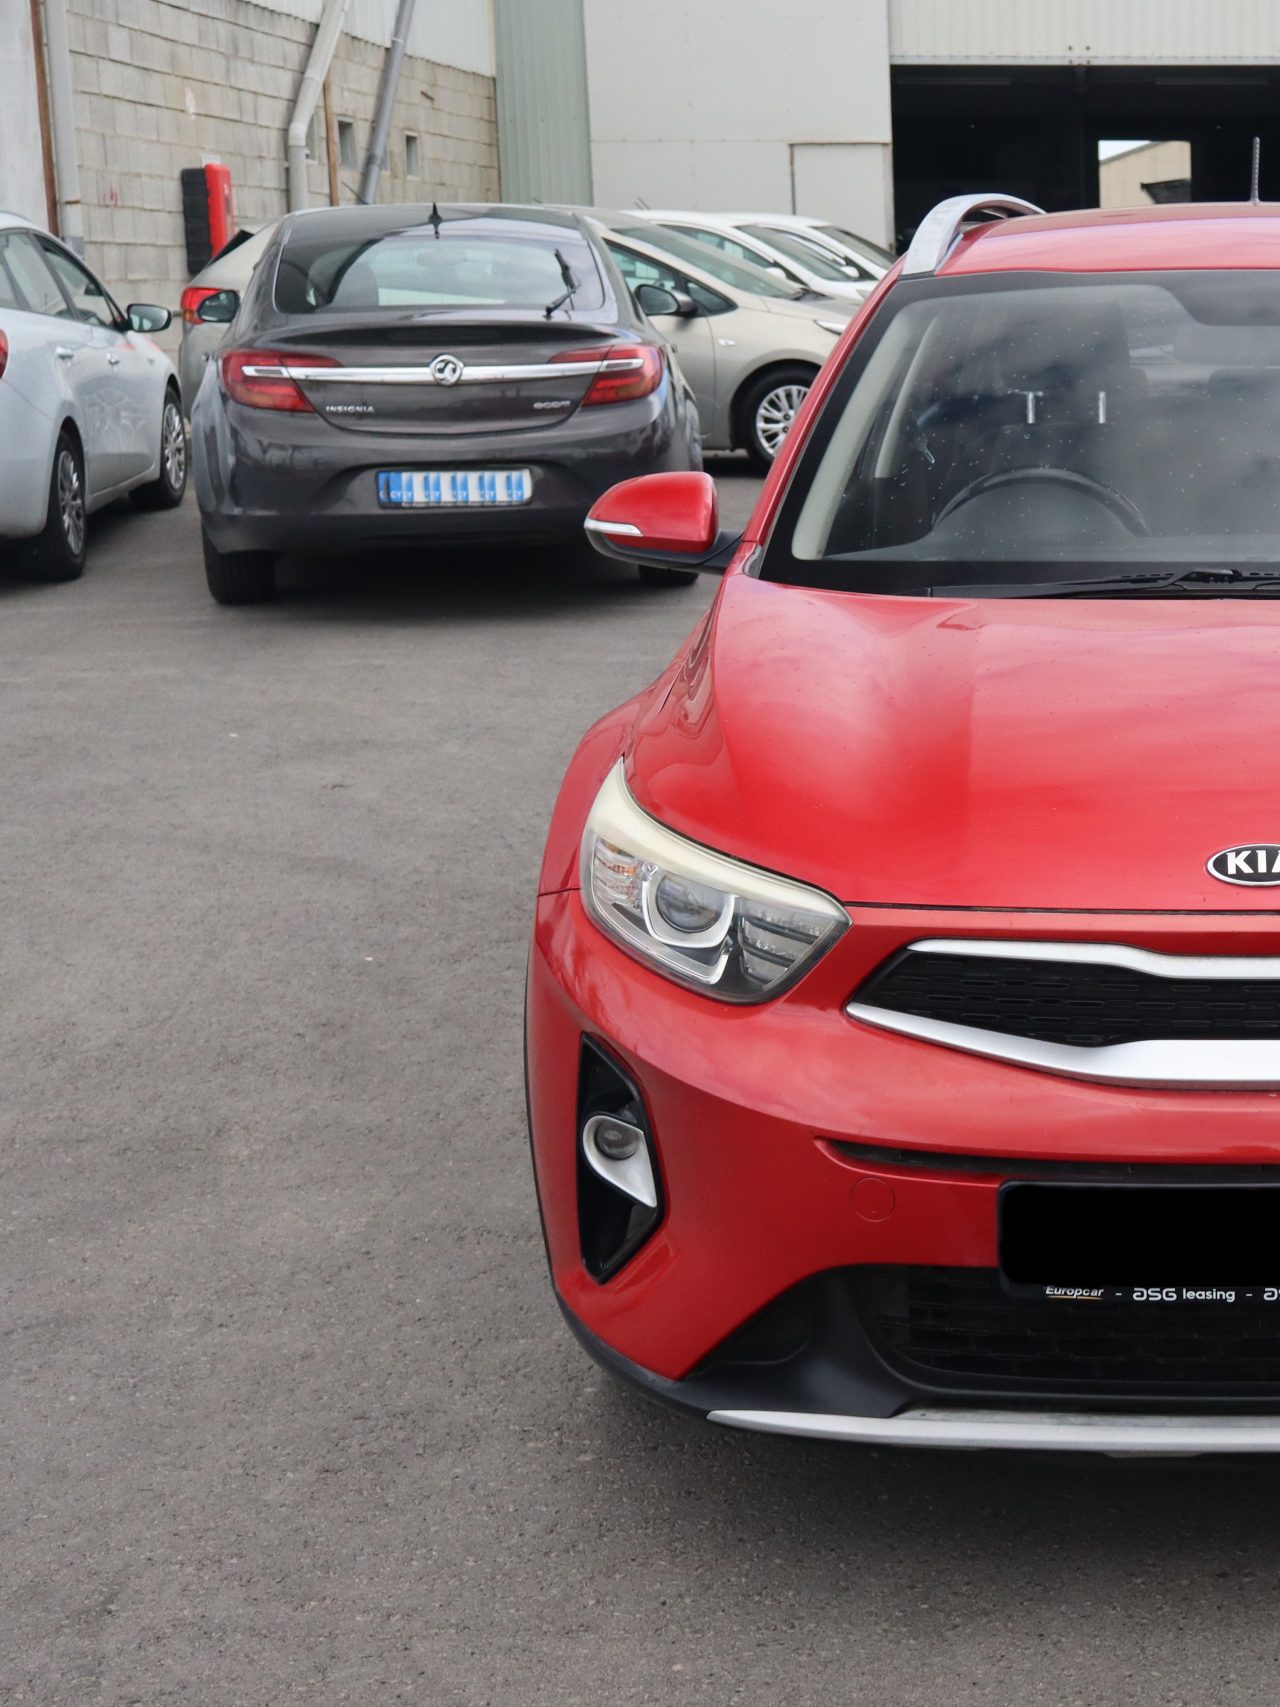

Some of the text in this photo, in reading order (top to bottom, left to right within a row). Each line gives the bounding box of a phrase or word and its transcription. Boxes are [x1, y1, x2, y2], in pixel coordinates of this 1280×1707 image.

[325, 404, 375, 413] INSIGNIA
[1045, 1285, 1104, 1299] Europcar
[1182, 1288, 1236, 1303] leasing
